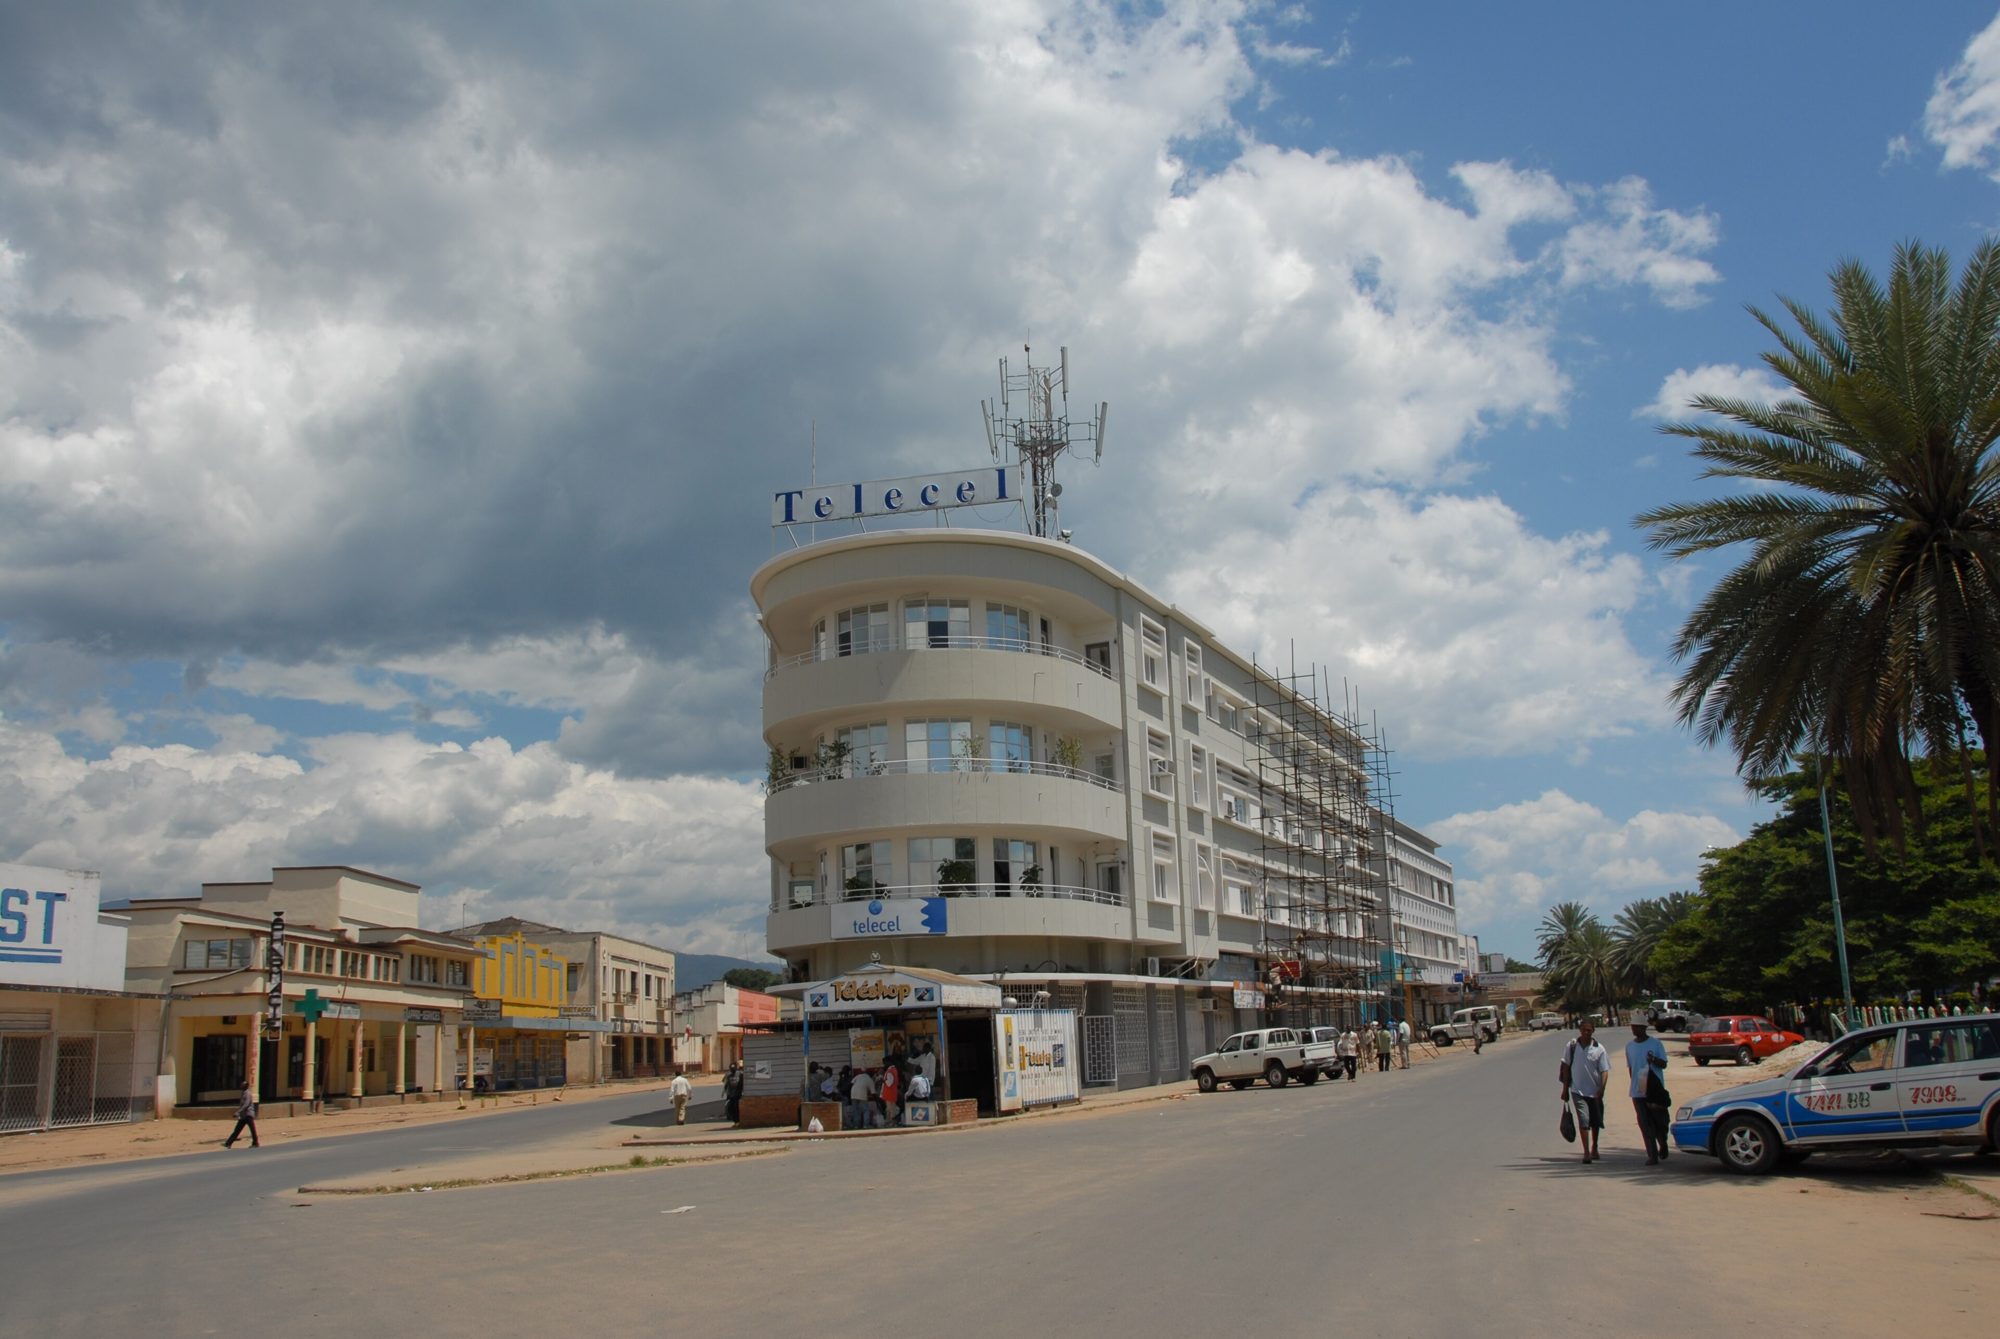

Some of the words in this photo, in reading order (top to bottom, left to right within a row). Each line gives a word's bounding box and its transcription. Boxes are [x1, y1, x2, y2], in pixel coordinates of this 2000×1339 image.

[775, 468, 1009, 523] Telecel
[0, 888, 67, 944] ST
[853, 915, 901, 933] telecel
[831, 979, 911, 1005] Téléshop
